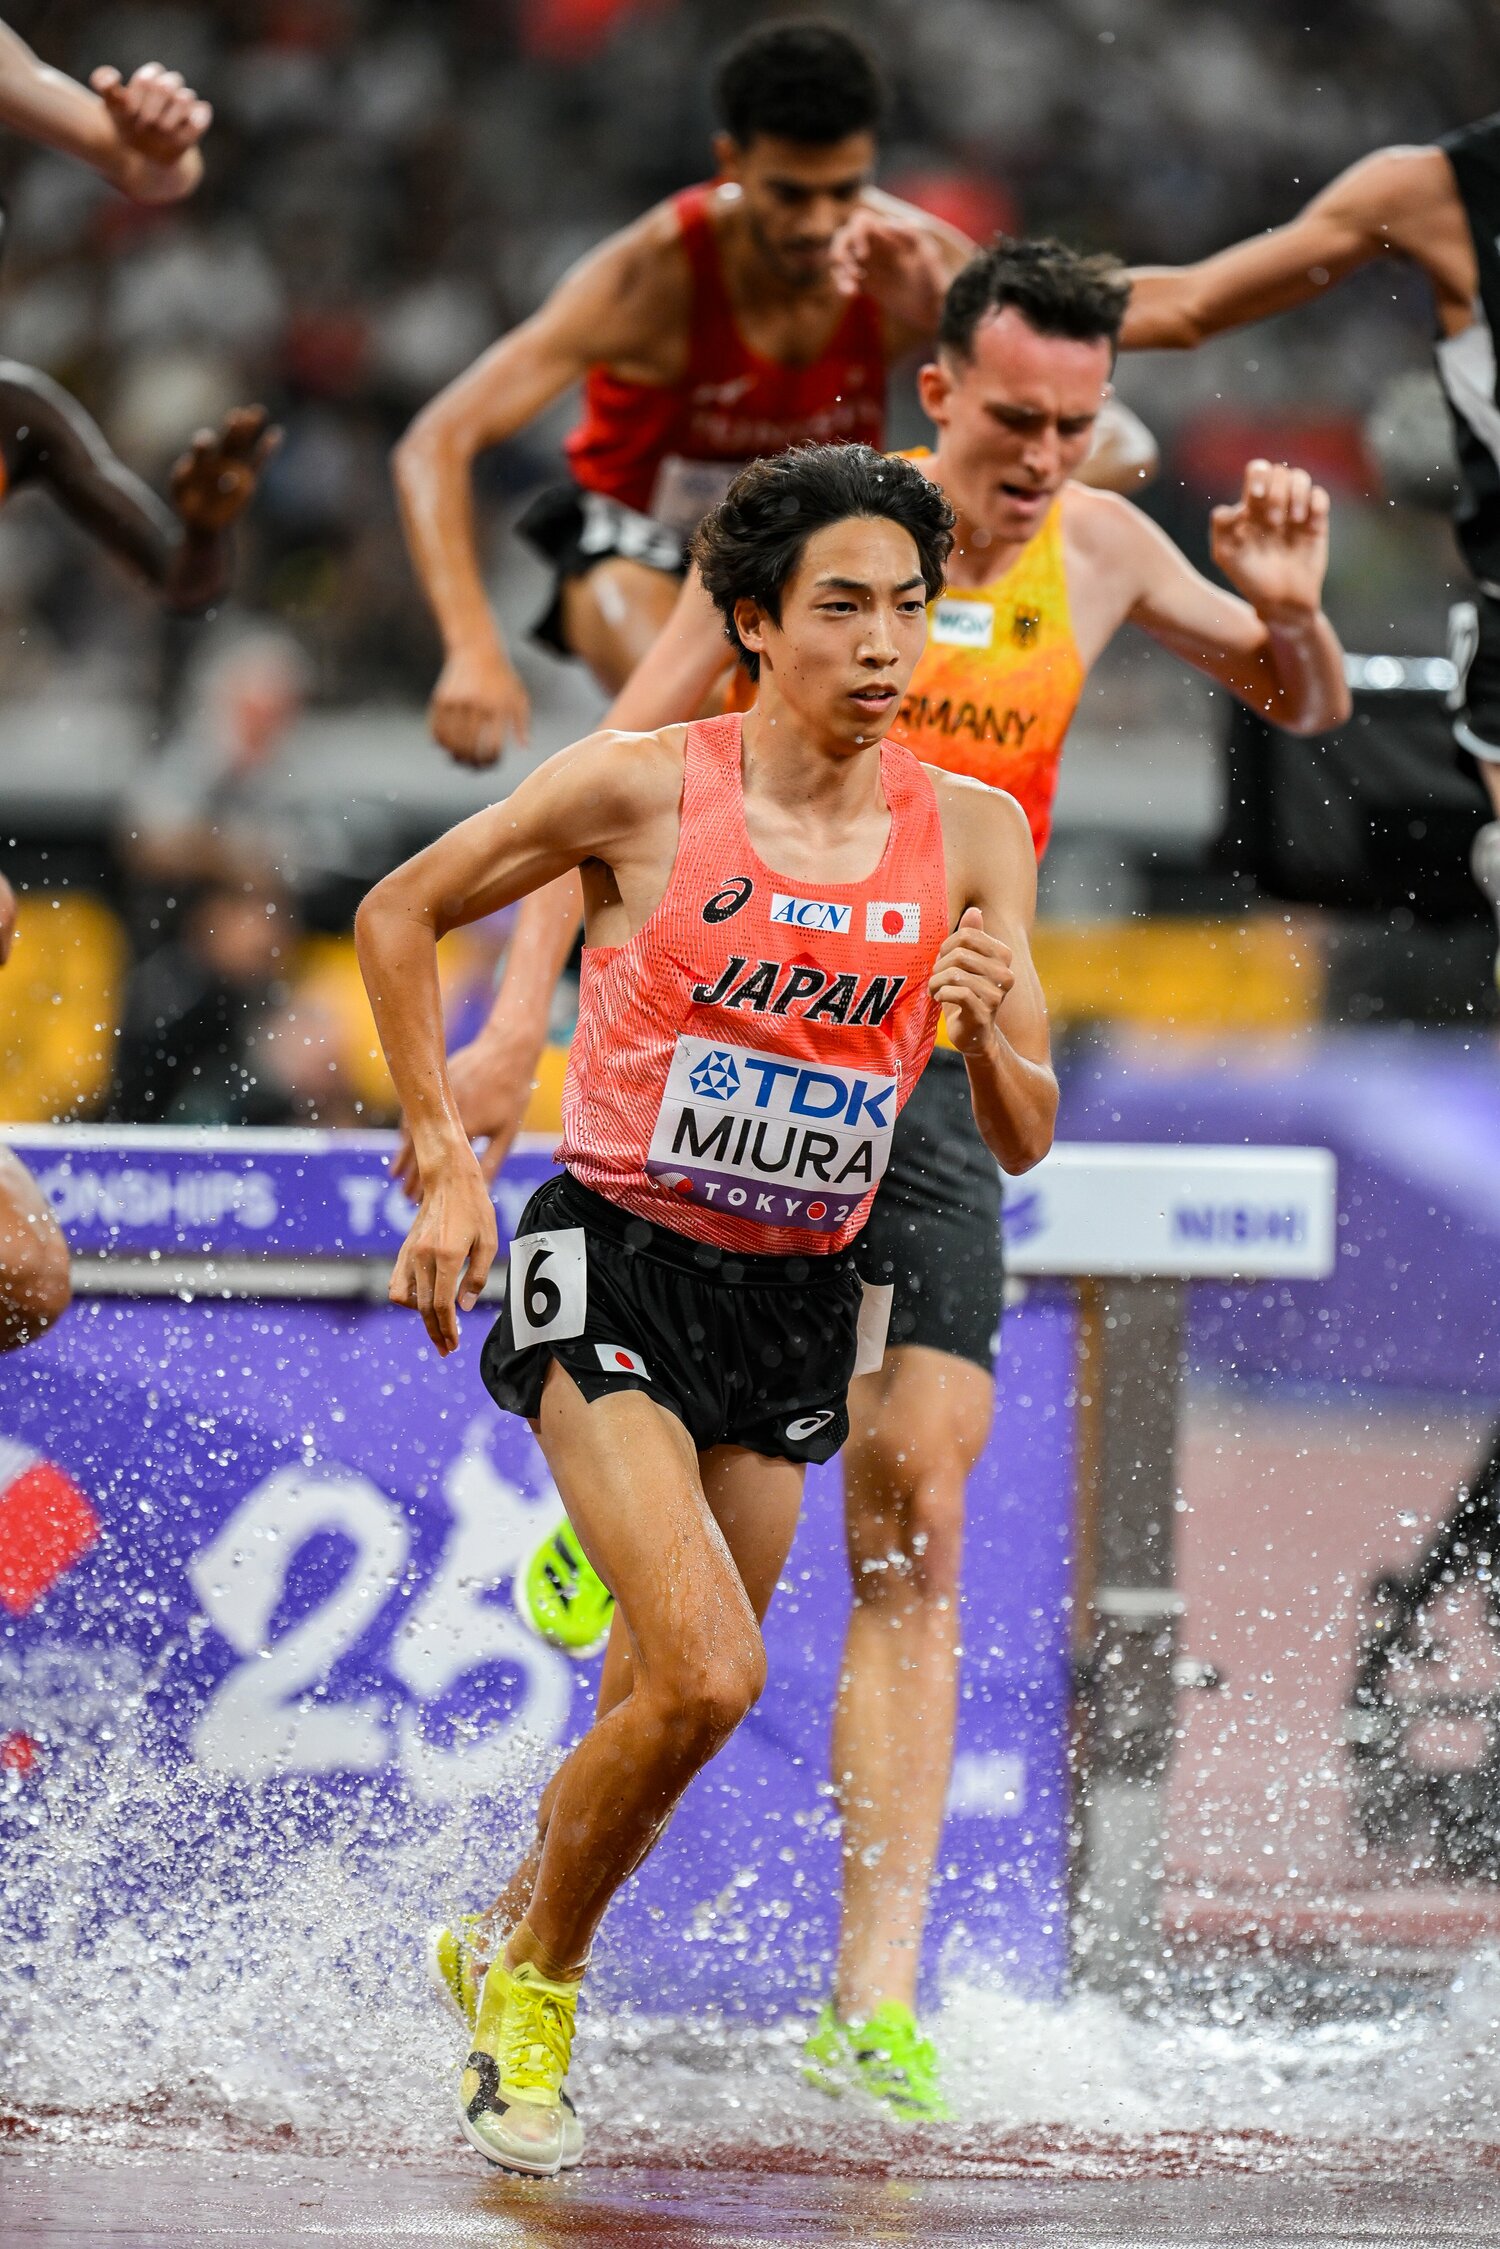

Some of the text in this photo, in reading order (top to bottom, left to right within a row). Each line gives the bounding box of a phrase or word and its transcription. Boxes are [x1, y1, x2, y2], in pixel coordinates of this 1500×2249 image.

[894, 694, 1038, 747] RMANY
[773, 900, 850, 930] ACN
[692, 955, 906, 1027] JAPAN
[745, 1058, 896, 1129] TDK
[671, 1107, 873, 1184] MIURA
[38, 1167, 279, 1230] ONSHIPS
[523, 1248, 562, 1329] 6
